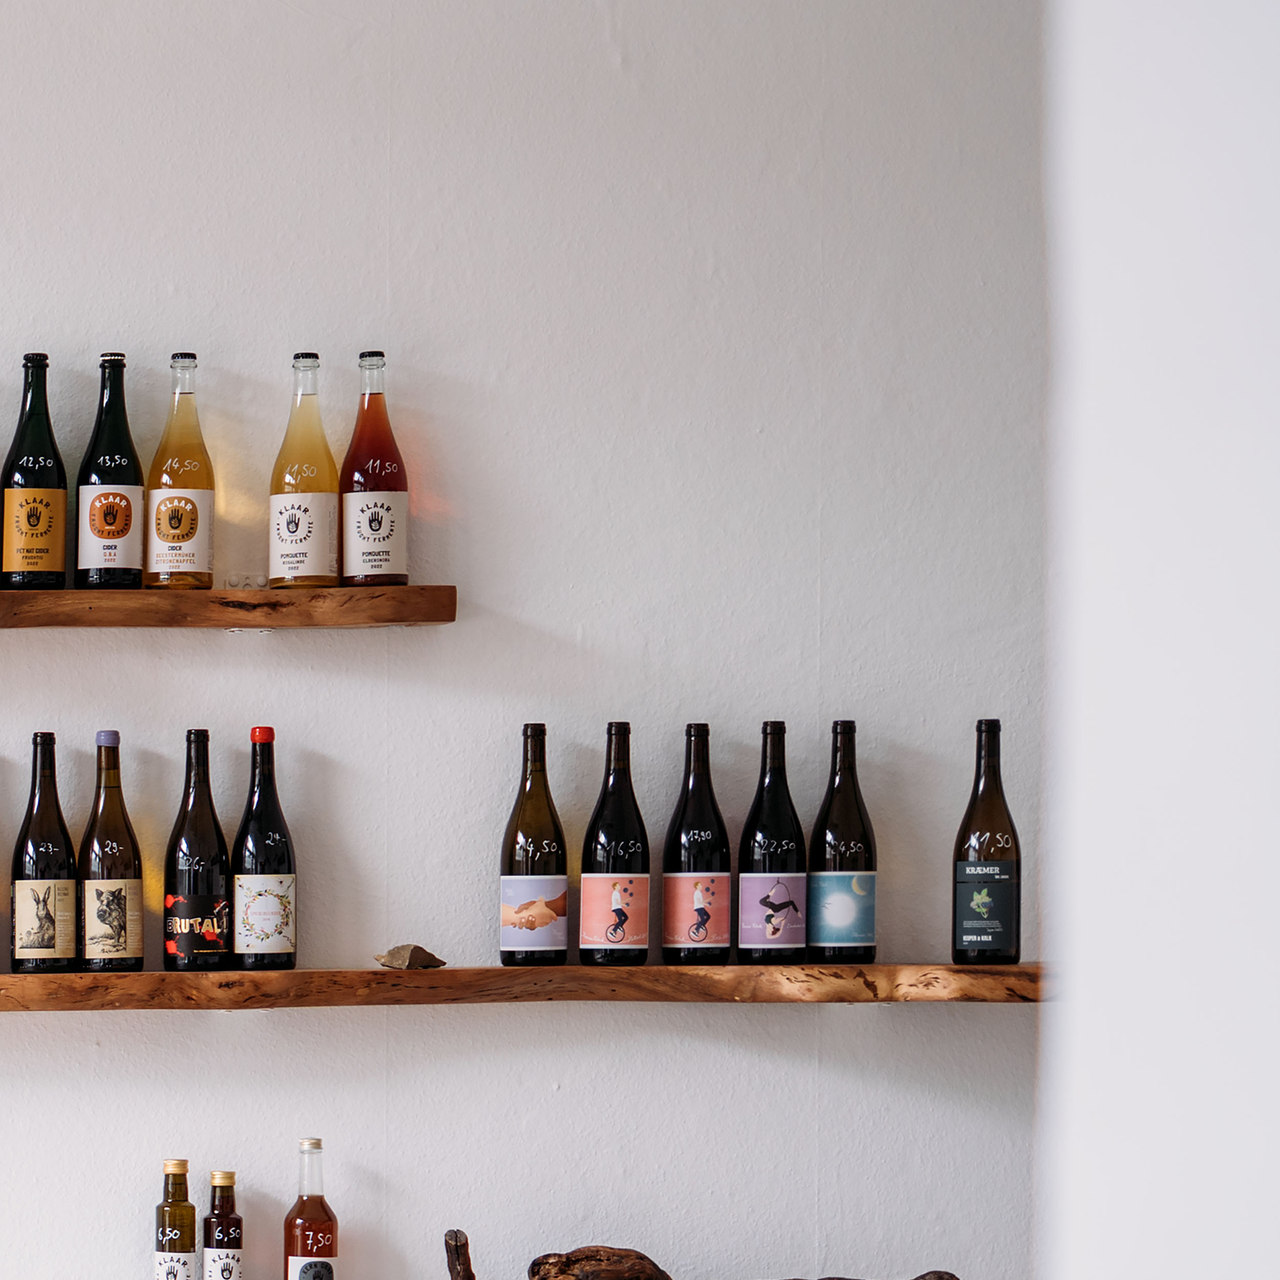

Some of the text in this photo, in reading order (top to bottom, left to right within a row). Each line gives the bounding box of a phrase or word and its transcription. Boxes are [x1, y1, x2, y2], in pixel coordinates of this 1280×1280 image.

[19, 456, 54, 470] 12,50
[97, 455, 128, 468] 13,50
[162, 457, 200, 475] 14,50
[365, 459, 398, 476] 11,50
[283, 463, 317, 483] 11,50
[18, 497, 51, 509] KLAAR
[94, 495, 127, 507] KLAAR
[160, 499, 193, 511] KLAAR
[360, 502, 392, 514] KLAAR
[278, 504, 310, 516] KLAAR
[14, 515, 54, 538] FRUCHT FERMENTE
[107, 514, 130, 537] FERMENTE
[156, 517, 196, 541] FRUCHT FERMENTE
[290, 521, 314, 544] FERMENTE
[356, 520, 395, 543] FRUCHT FERMENTE
[687, 829, 712, 842] 17,90
[962, 831, 1012, 854] 11,50
[606, 840, 643, 859] 16,50
[760, 838, 796, 854] 22,50
[965, 866, 1000, 874] KRÆMER
[157, 1226, 180, 1244] 6,50
[215, 1226, 241, 1242] 6,50
[305, 1231, 333, 1252] 7,50
[158, 1256, 188, 1268] KLAAR
[211, 1253, 241, 1264] KLAAR
